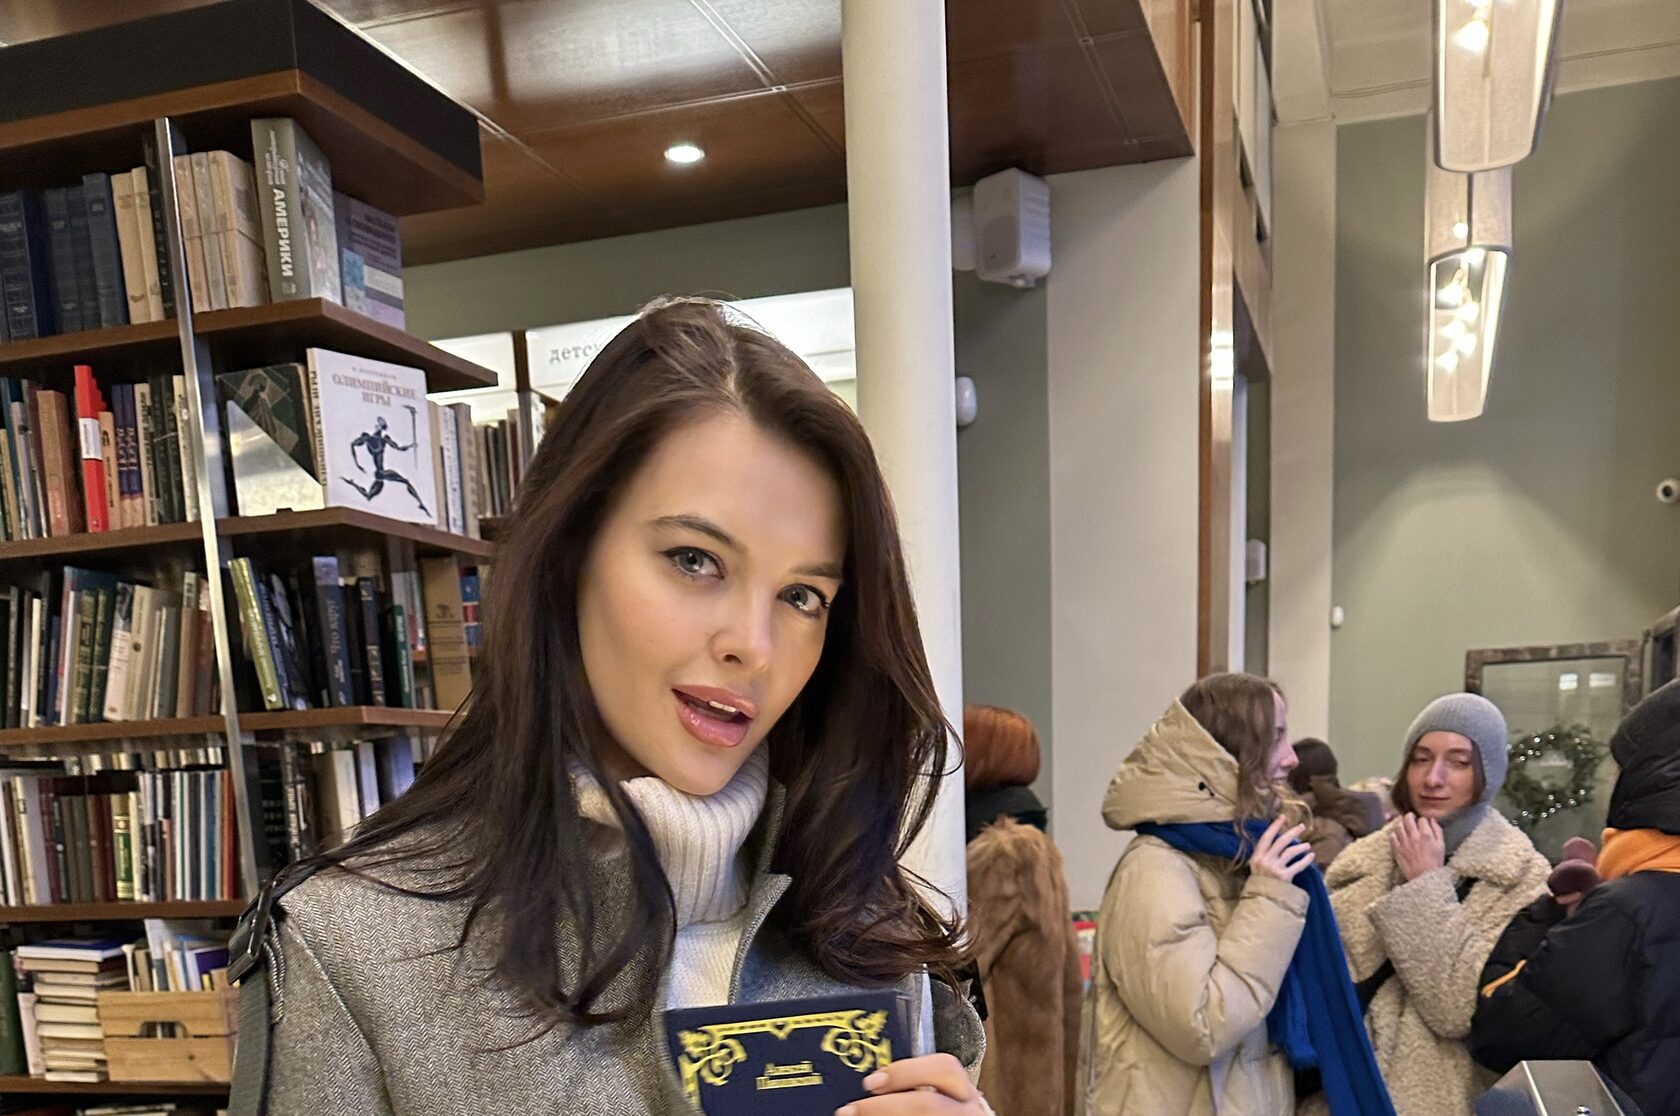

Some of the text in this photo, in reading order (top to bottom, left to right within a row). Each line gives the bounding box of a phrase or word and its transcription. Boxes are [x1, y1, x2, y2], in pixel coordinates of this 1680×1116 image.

[273, 188, 293, 277] АМЕРИКИ
[332, 374, 416, 400] ОЛИМПИЙСКИЕ
[361, 392, 391, 406] ИГРЫ
